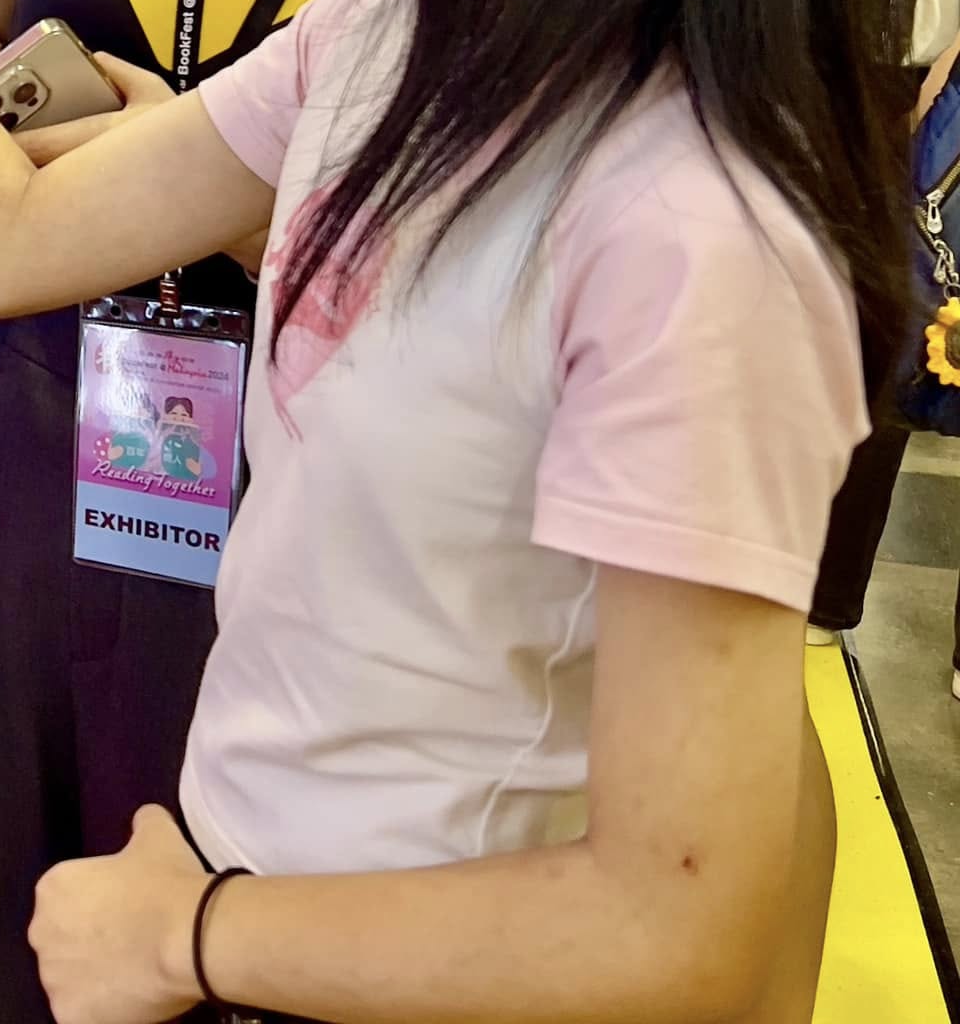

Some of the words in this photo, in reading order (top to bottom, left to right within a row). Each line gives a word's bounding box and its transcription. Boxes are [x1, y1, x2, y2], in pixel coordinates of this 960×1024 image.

[177, 12, 194, 75] BookFest
[92, 459, 154, 491] Reading
[152, 471, 216, 496] Together
[84, 508, 220, 552] EXHIBITOR
